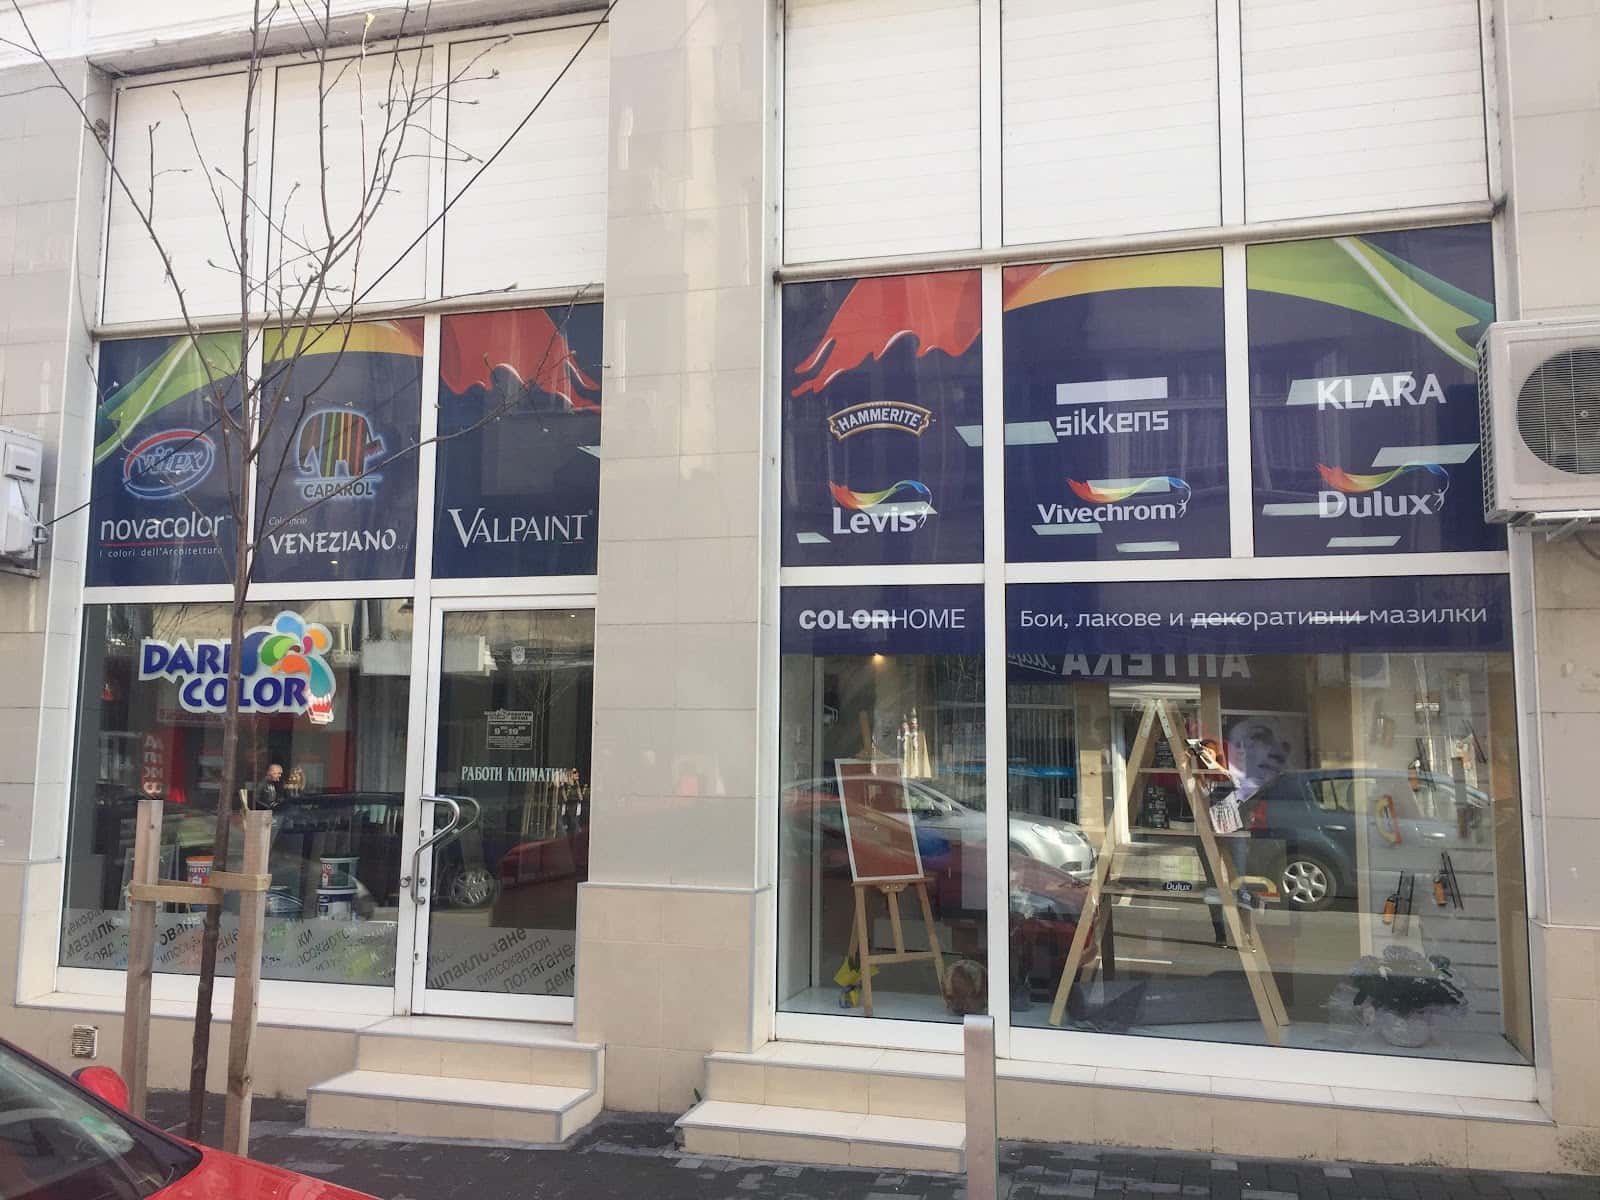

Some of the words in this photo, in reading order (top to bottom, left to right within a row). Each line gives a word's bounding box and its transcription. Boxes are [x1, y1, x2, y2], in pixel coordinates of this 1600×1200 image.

[1317, 374, 1447, 411] KLARA
[837, 407, 922, 431] HAMMERITE
[1055, 407, 1169, 437] sikkens
[303, 482, 373, 498] CAPAROL
[1037, 503, 1176, 524] Vivechrom
[1318, 490, 1433, 519] Dulux
[101, 511, 225, 541] novacolor
[447, 507, 589, 548] VALPAINT
[832, 506, 918, 535] Levis
[268, 528, 397, 555] VENEZIANO
[798, 608, 966, 631] COLORHOME
[1020, 610, 1069, 630] Бои,
[1075, 611, 1162, 628] лакове
[1169, 611, 1185, 627] и
[1190, 610, 1361, 632] декоративни
[1369, 607, 1488, 625] мазилки
[183, 677, 308, 708] COLOR
[1165, 881, 1192, 891] Dulux
